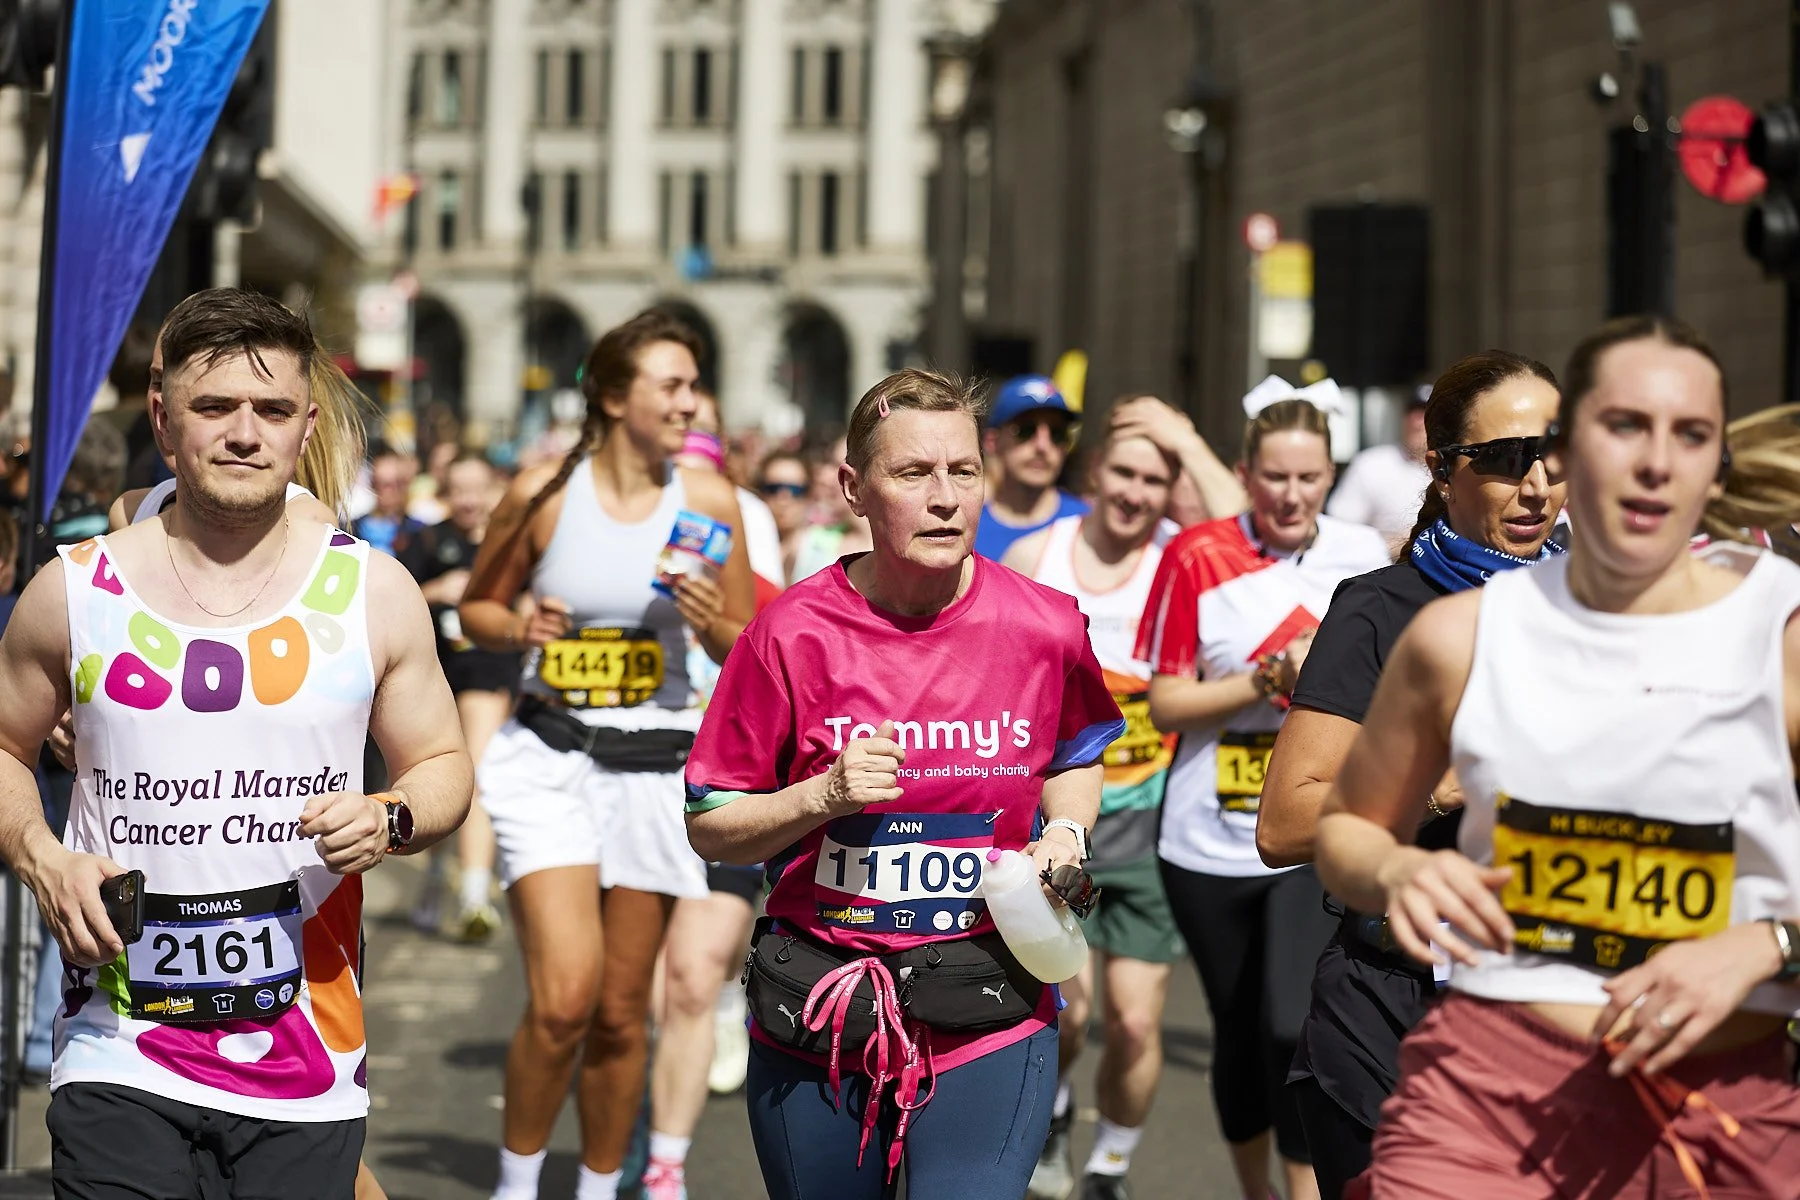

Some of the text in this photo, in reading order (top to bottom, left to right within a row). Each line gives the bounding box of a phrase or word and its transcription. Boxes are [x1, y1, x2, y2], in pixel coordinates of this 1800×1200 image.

[553, 651, 655, 677] 14419
[824, 711, 1031, 758] Tommy's
[924, 765, 950, 777] and
[954, 764, 988, 778] baby
[992, 763, 1030, 777] charity
[93, 766, 348, 807] The Royal Marsden
[109, 814, 314, 846] Cancer Char
[888, 822, 923, 834] ANN
[829, 848, 982, 893] 11109
[1509, 849, 1716, 920] 12140
[178, 898, 243, 915] THOMAS
[152, 926, 274, 976] 2161
[144, 1001, 166, 1012] LONDON
[900, 1102, 911, 1125] Tomm's
